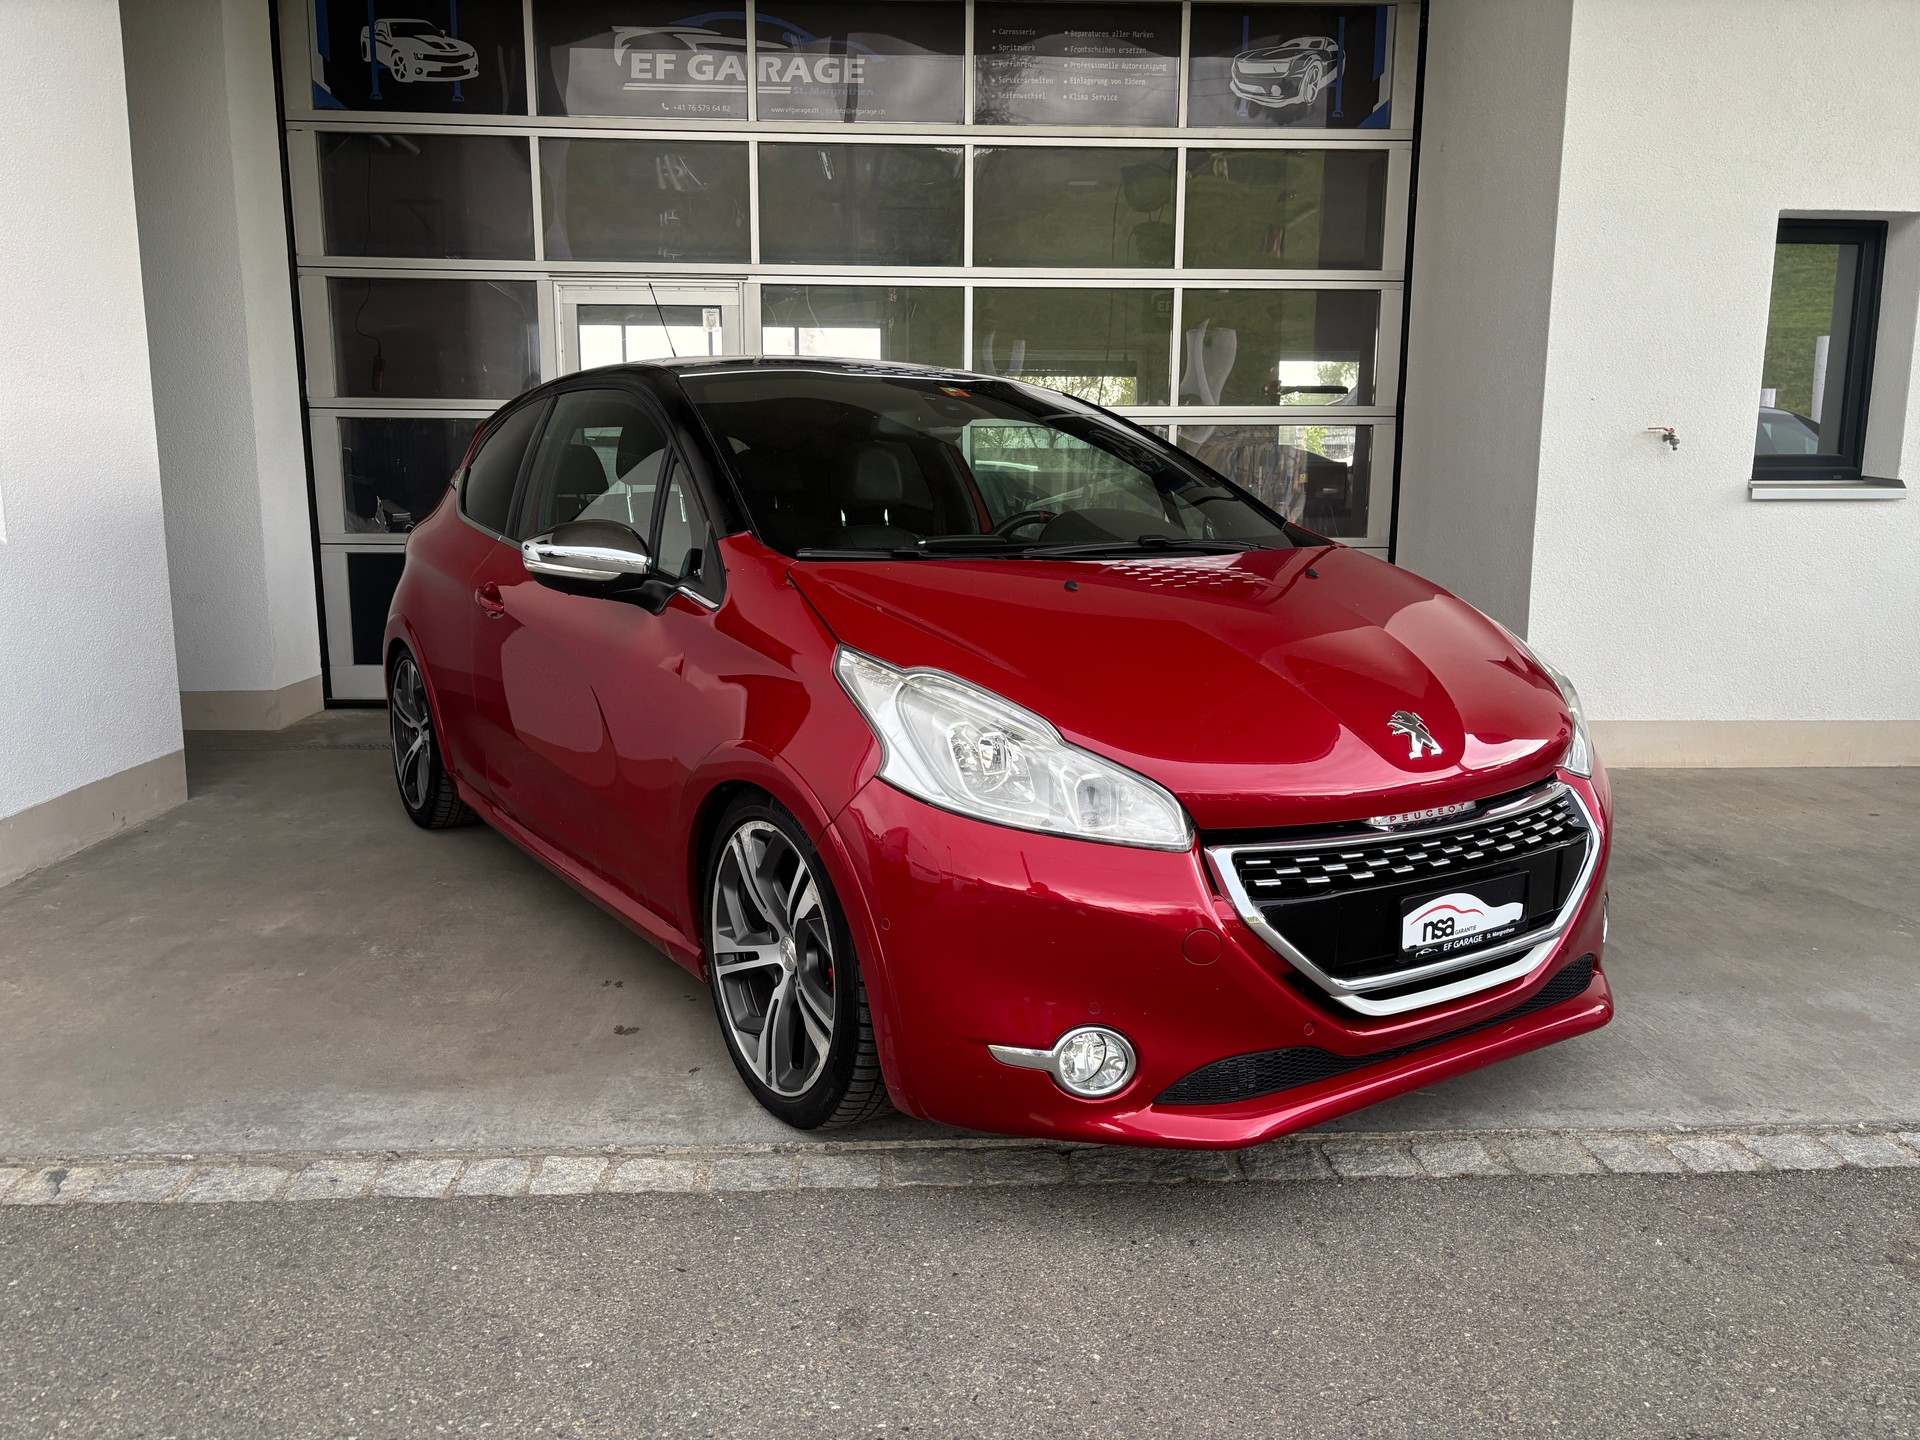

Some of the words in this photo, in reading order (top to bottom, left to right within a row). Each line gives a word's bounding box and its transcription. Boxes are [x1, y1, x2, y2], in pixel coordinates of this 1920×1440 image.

[998, 28, 1036, 36] Carrosserie
[1070, 30, 1109, 38] Reparaturen
[1112, 30, 1129, 38] aller
[998, 44, 1036, 52] Spritzwerk
[1070, 45, 1116, 54] Frontscheiben
[631, 52, 677, 79] EF
[687, 54, 865, 84] GARAGE
[1070, 61, 1119, 70] Professionelle
[1121, 62, 1167, 72] Autoreinigung
[1070, 76, 1108, 86] Einlagerung
[1070, 92, 1089, 101] Klima
[1091, 93, 1118, 101] Service
[673, 104, 686, 112] +41
[688, 104, 697, 112] 76
[698, 104, 710, 112] 579
[1389, 803, 1465, 823] PEUGEOT
[1422, 917, 1455, 942] nsa
[1454, 925, 1477, 935] GARANTIE
[1443, 943, 1453, 952] EF
[1453, 934, 1484, 949] GARAGE
